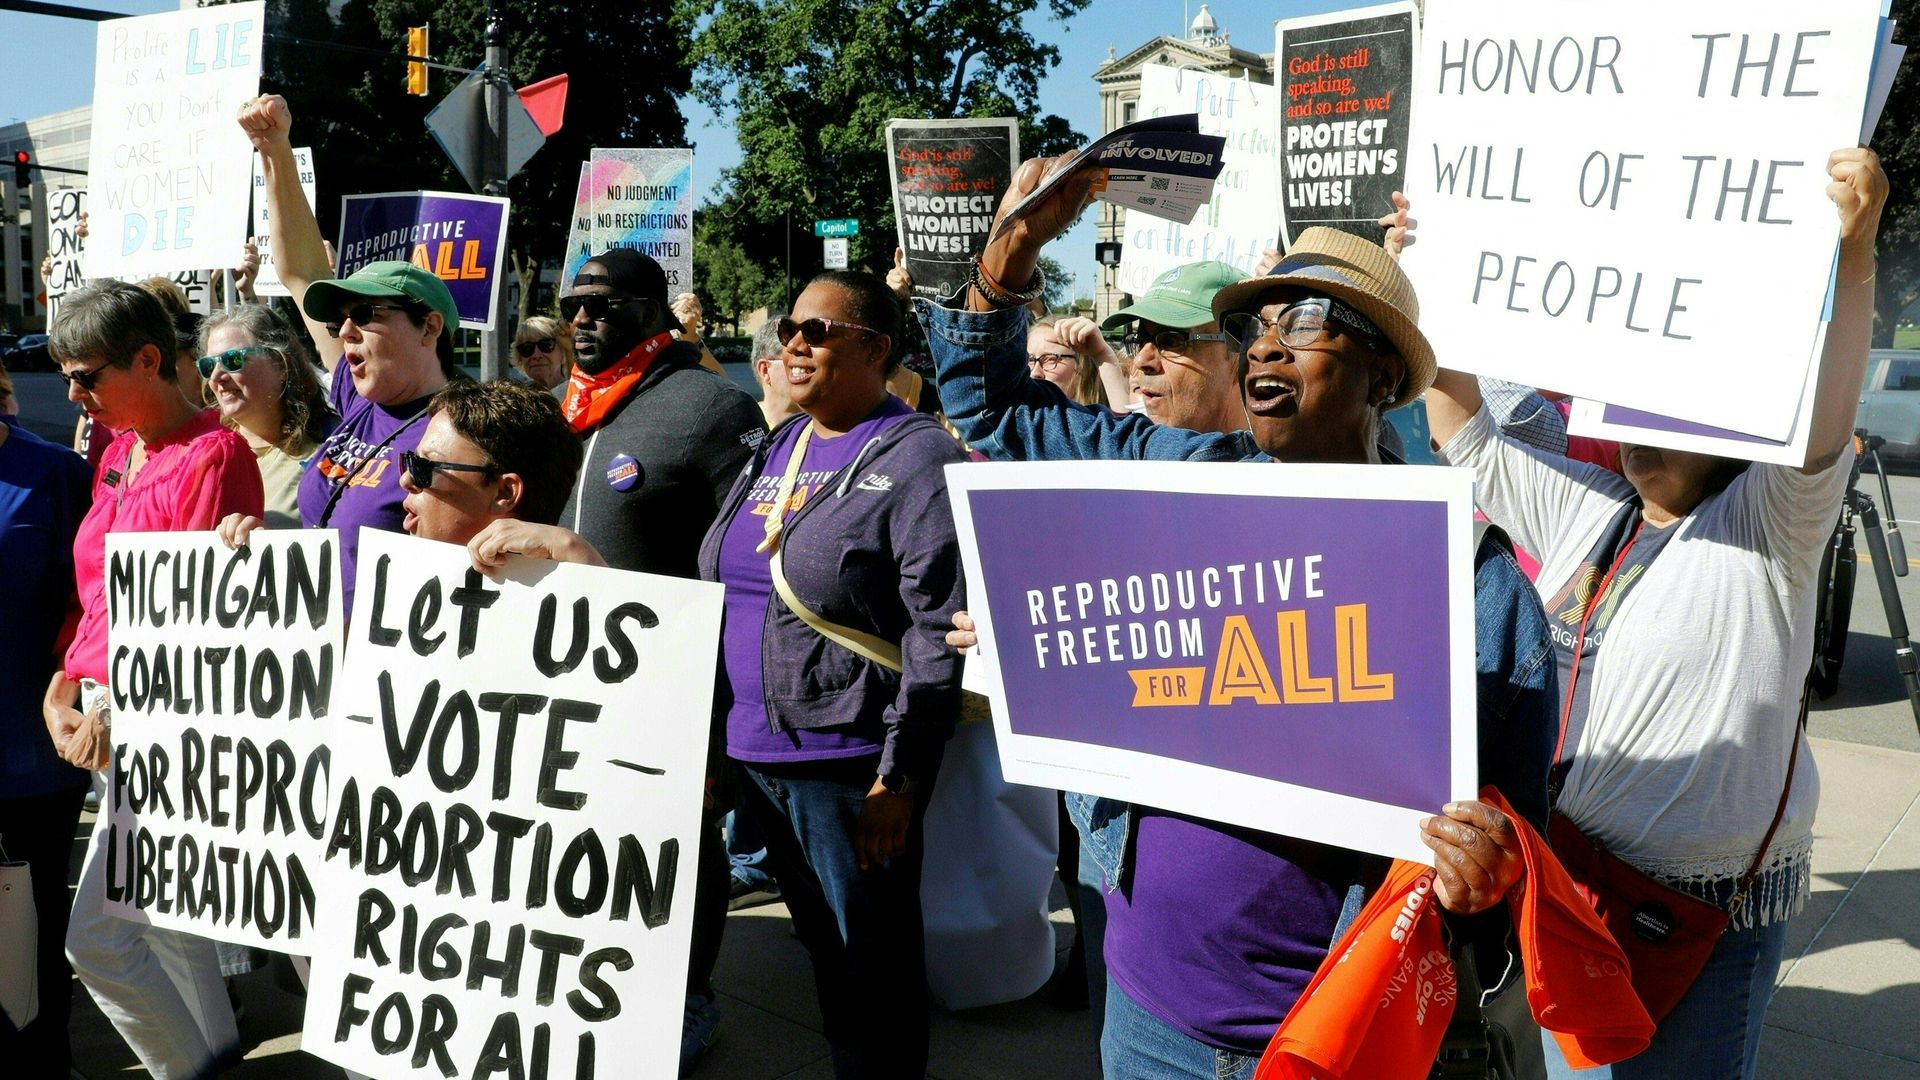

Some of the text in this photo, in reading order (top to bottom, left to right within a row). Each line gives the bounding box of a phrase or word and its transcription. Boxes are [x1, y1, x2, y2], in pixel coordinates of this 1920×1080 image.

[113, 27, 168, 63] Prolife
[186, 19, 253, 75] LIE
[1288, 48, 1370, 75] God is still
[1438, 30, 1831, 98] HONOR THE
[126, 68, 165, 86] IS A
[1287, 75, 1357, 99] speaking,
[126, 89, 221, 130] YOU Don't
[1196, 78, 1239, 118] Put
[1287, 91, 1393, 118] and so are we!
[113, 129, 206, 168] CARE IF
[899, 146, 973, 161] God is still
[1107, 140, 1134, 149] GET
[1287, 118, 1388, 150] PROTECT
[1101, 148, 1213, 166] INVOLVED!
[1286, 149, 1398, 179] WOMEN'S
[105, 161, 213, 210] WOMEN
[607, 185, 678, 200] NO JUDGMENT
[947, 181, 968, 192] are
[972, 176, 995, 190] we!
[1288, 179, 1351, 207] LIVES!
[1432, 143, 1804, 225] WILL OF THE
[598, 213, 688, 229] NO RESTRICTIONS
[904, 195, 994, 214] PROTECT
[905, 215, 993, 233] WOMEN'
[122, 206, 194, 256] DIE
[345, 220, 466, 260] REPRODUCTIVE
[822, 222, 847, 234] Capitol
[908, 235, 970, 253] LIVES!
[1133, 228, 1159, 249] on
[410, 239, 486, 281] ALL
[1472, 251, 1702, 340] PEOPLE
[110, 539, 332, 631] MICHIGAN
[1027, 554, 1324, 625] REPRODUCTIVE
[368, 553, 661, 684] Let US
[1034, 618, 1204, 669] FREEDOM
[1148, 603, 1395, 708] FOR ALL
[112, 642, 334, 721] COALITION
[377, 669, 603, 811] VOTE
[114, 726, 333, 841] FOR REPRO
[324, 775, 679, 930] ABORTION
[106, 824, 316, 940] LIBERATION
[1390, 871, 1434, 944] ODIES
[353, 887, 634, 1023] RIGHTS
[334, 973, 459, 1078] FOR
